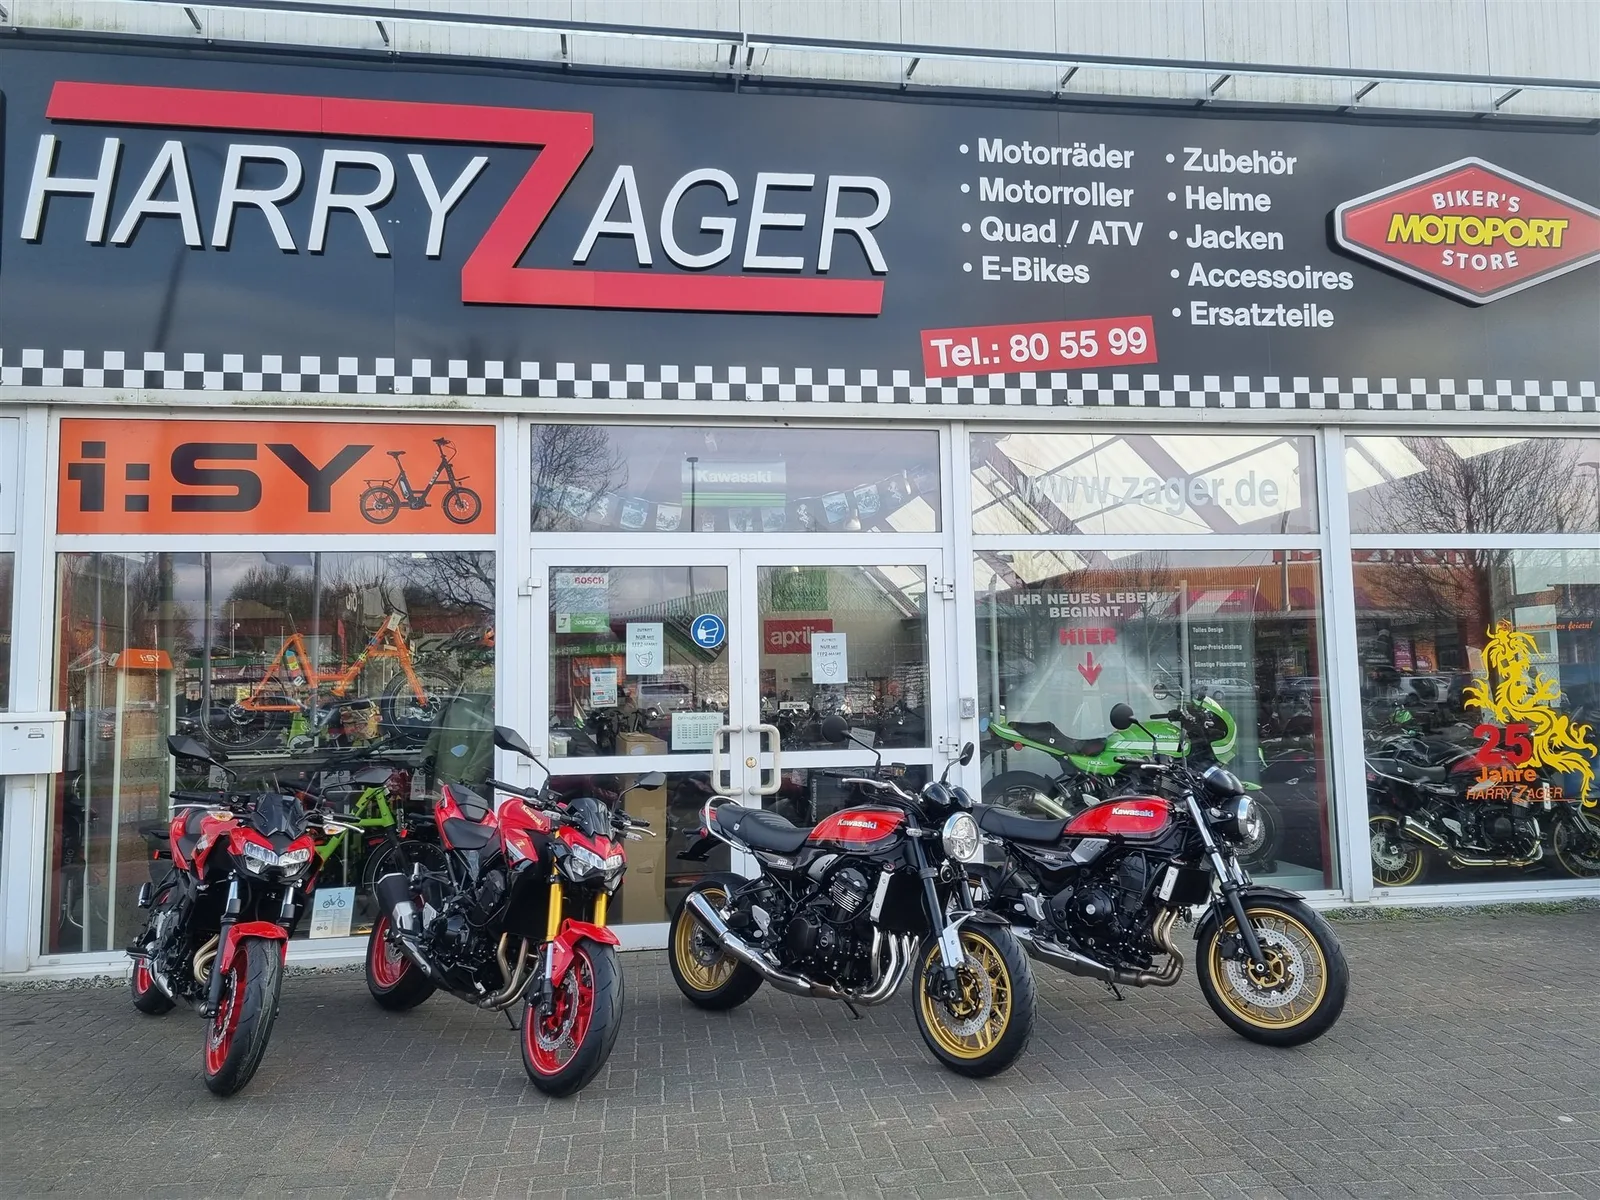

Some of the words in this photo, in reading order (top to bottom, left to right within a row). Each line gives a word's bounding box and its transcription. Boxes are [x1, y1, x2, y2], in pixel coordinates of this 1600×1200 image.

[978, 138, 1135, 168] Motorräder
[1183, 147, 1297, 175] Zubehör
[979, 177, 1134, 207] Motorroller
[1185, 185, 1271, 212] Helme
[1432, 190, 1521, 213] BIKER'S
[980, 216, 1056, 242] Quad
[1088, 220, 1144, 246] ATV
[1186, 224, 1284, 250] Jacken
[1386, 213, 1569, 248] MOTOPORT
[982, 256, 1090, 284] E-Bikes
[1441, 249, 1519, 271] STORE
[1187, 262, 1354, 290] Accessoires
[1190, 301, 1335, 327] Ersatzteile
[930, 337, 1000, 368] Tel.:
[1009, 334, 1049, 363] 80
[1060, 330, 1099, 359] 55
[1108, 326, 1147, 355] 99
[68, 441, 374, 512] i:SY
[697, 470, 772, 483] Kawasaki
[1017, 470, 1279, 516] www.zager.de
[574, 576, 605, 585] BOSCH
[1013, 594, 1042, 605] IHR
[1047, 593, 1101, 605] NEUES
[1106, 592, 1158, 604] LEBEN
[1049, 606, 1124, 618] BEGINNT.
[770, 626, 826, 648] april
[1059, 628, 1118, 646] HIER
[1473, 724, 1533, 763] 25
[1476, 766, 1537, 783] Jahre
[1466, 786, 1514, 800] HARRY
[837, 818, 878, 830] Kawasaki
[1112, 807, 1155, 817] Kawasaki
